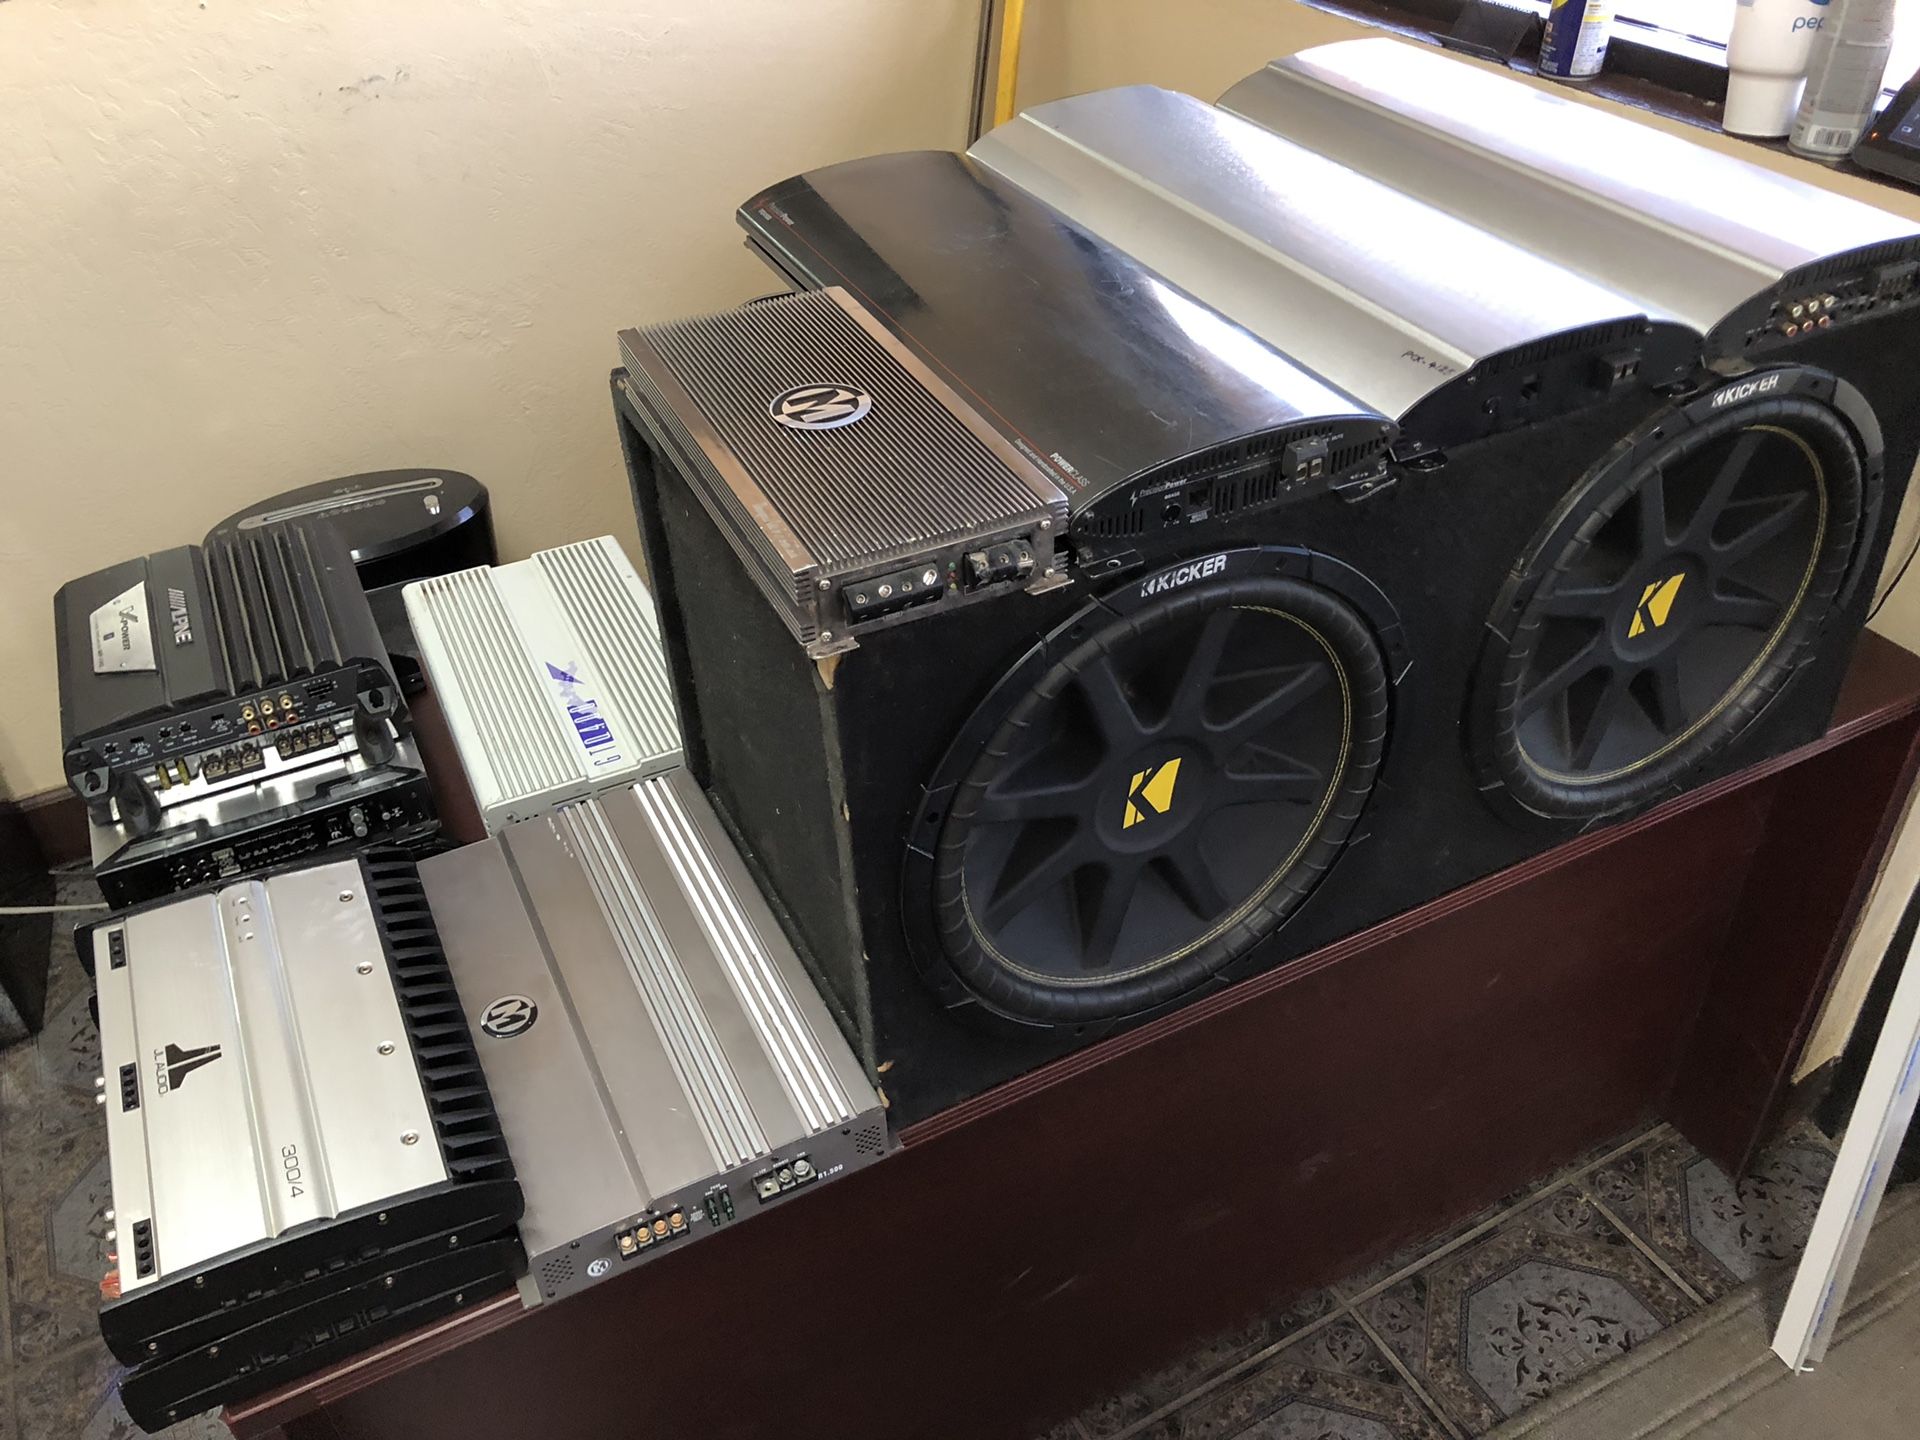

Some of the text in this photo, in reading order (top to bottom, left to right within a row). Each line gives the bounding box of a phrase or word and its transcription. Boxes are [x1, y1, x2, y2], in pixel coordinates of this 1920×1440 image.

[1151, 554, 1228, 595] KICKER
[155, 1062, 169, 1096] AUDIO
[281, 1144, 305, 1199] 300/4
